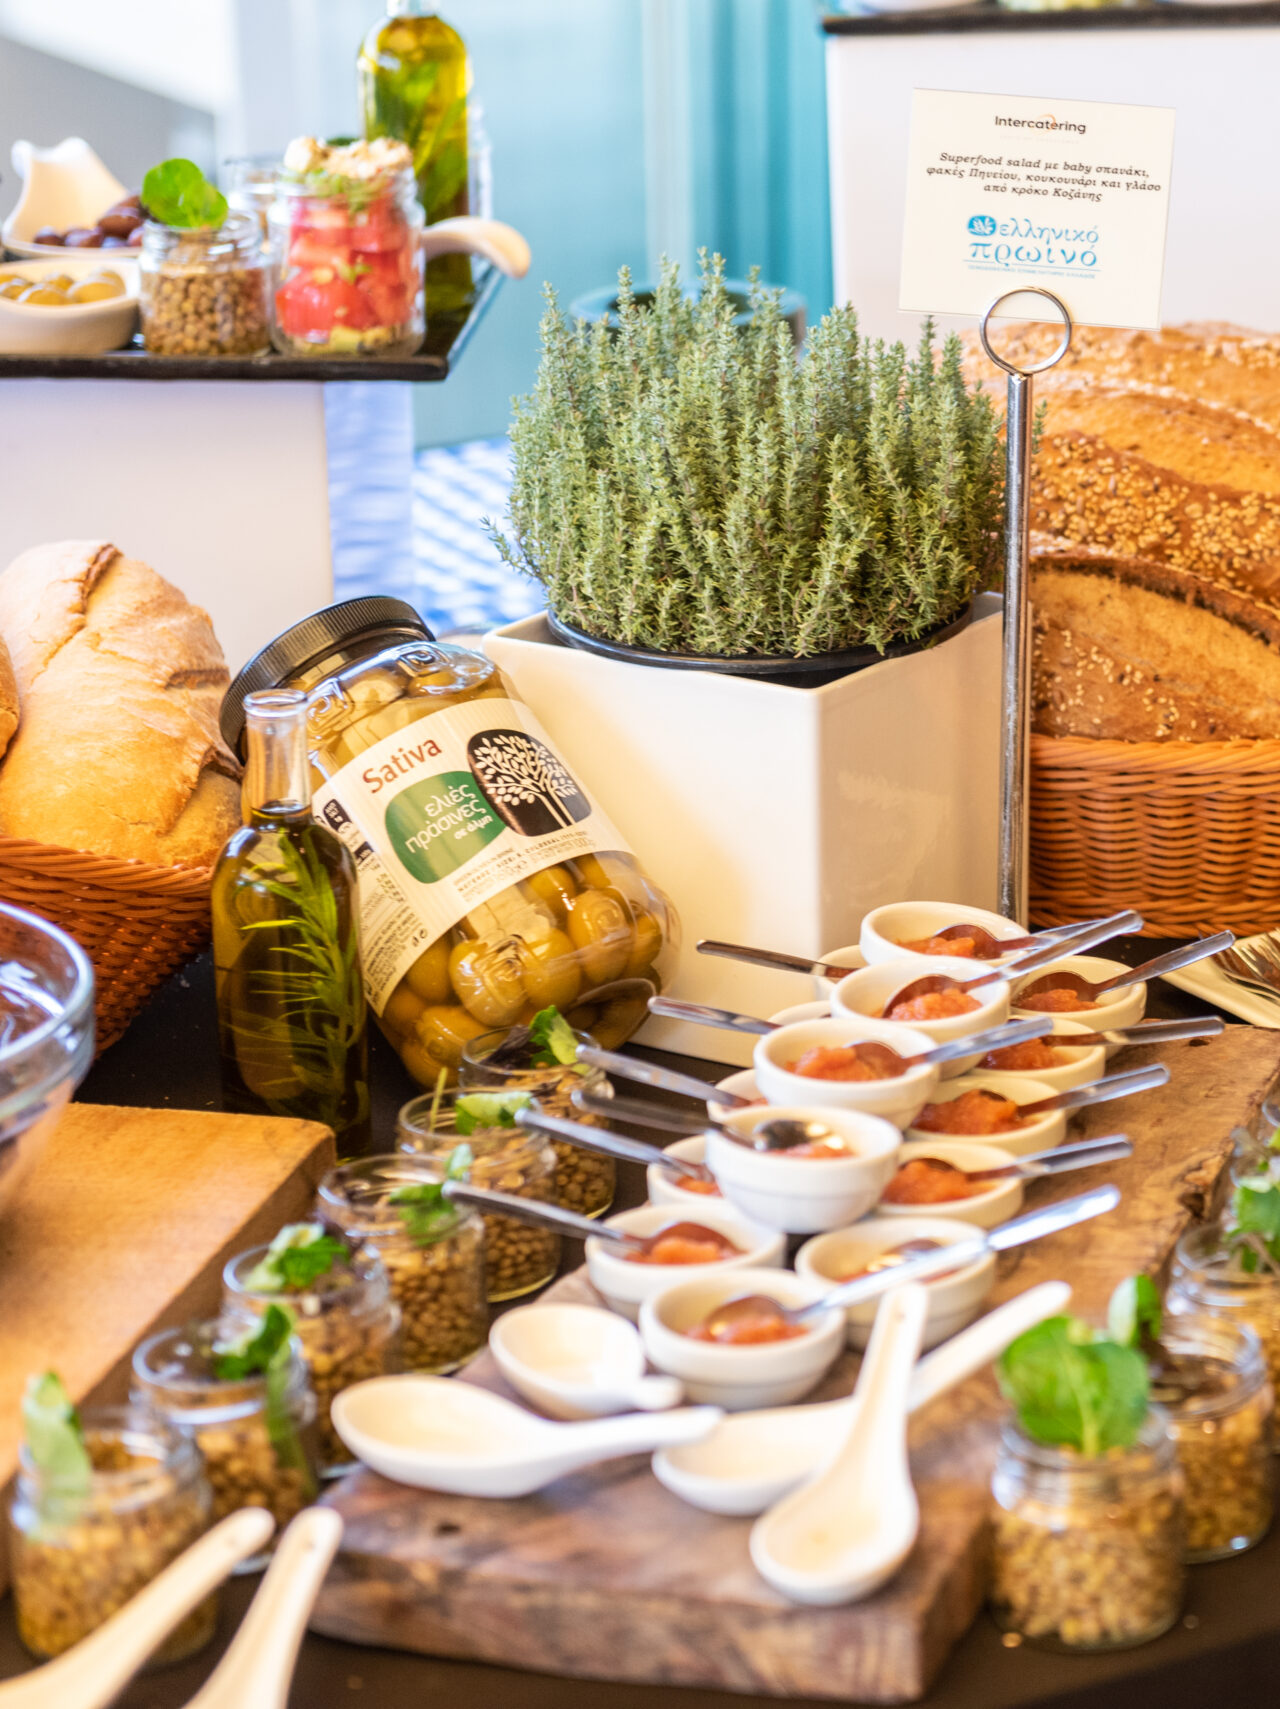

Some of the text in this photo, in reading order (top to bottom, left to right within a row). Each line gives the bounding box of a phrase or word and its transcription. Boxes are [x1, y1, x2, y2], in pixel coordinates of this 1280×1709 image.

[994, 115, 1087, 135] Intercatering
[939, 152, 1150, 178] Superfood salad με baby σπανάκι,
[926, 166, 1162, 192] φακές Πηνείου, κουκουνάρι και γλάσο
[983, 182, 1104, 202] από κρόκο Κοζάνης
[999, 217, 1100, 245] ελληνικό
[362, 738, 443, 794] Sativa
[424, 783, 477, 818] ελιές
[404, 798, 487, 854] πράσινες
[453, 829, 469, 841] σε
